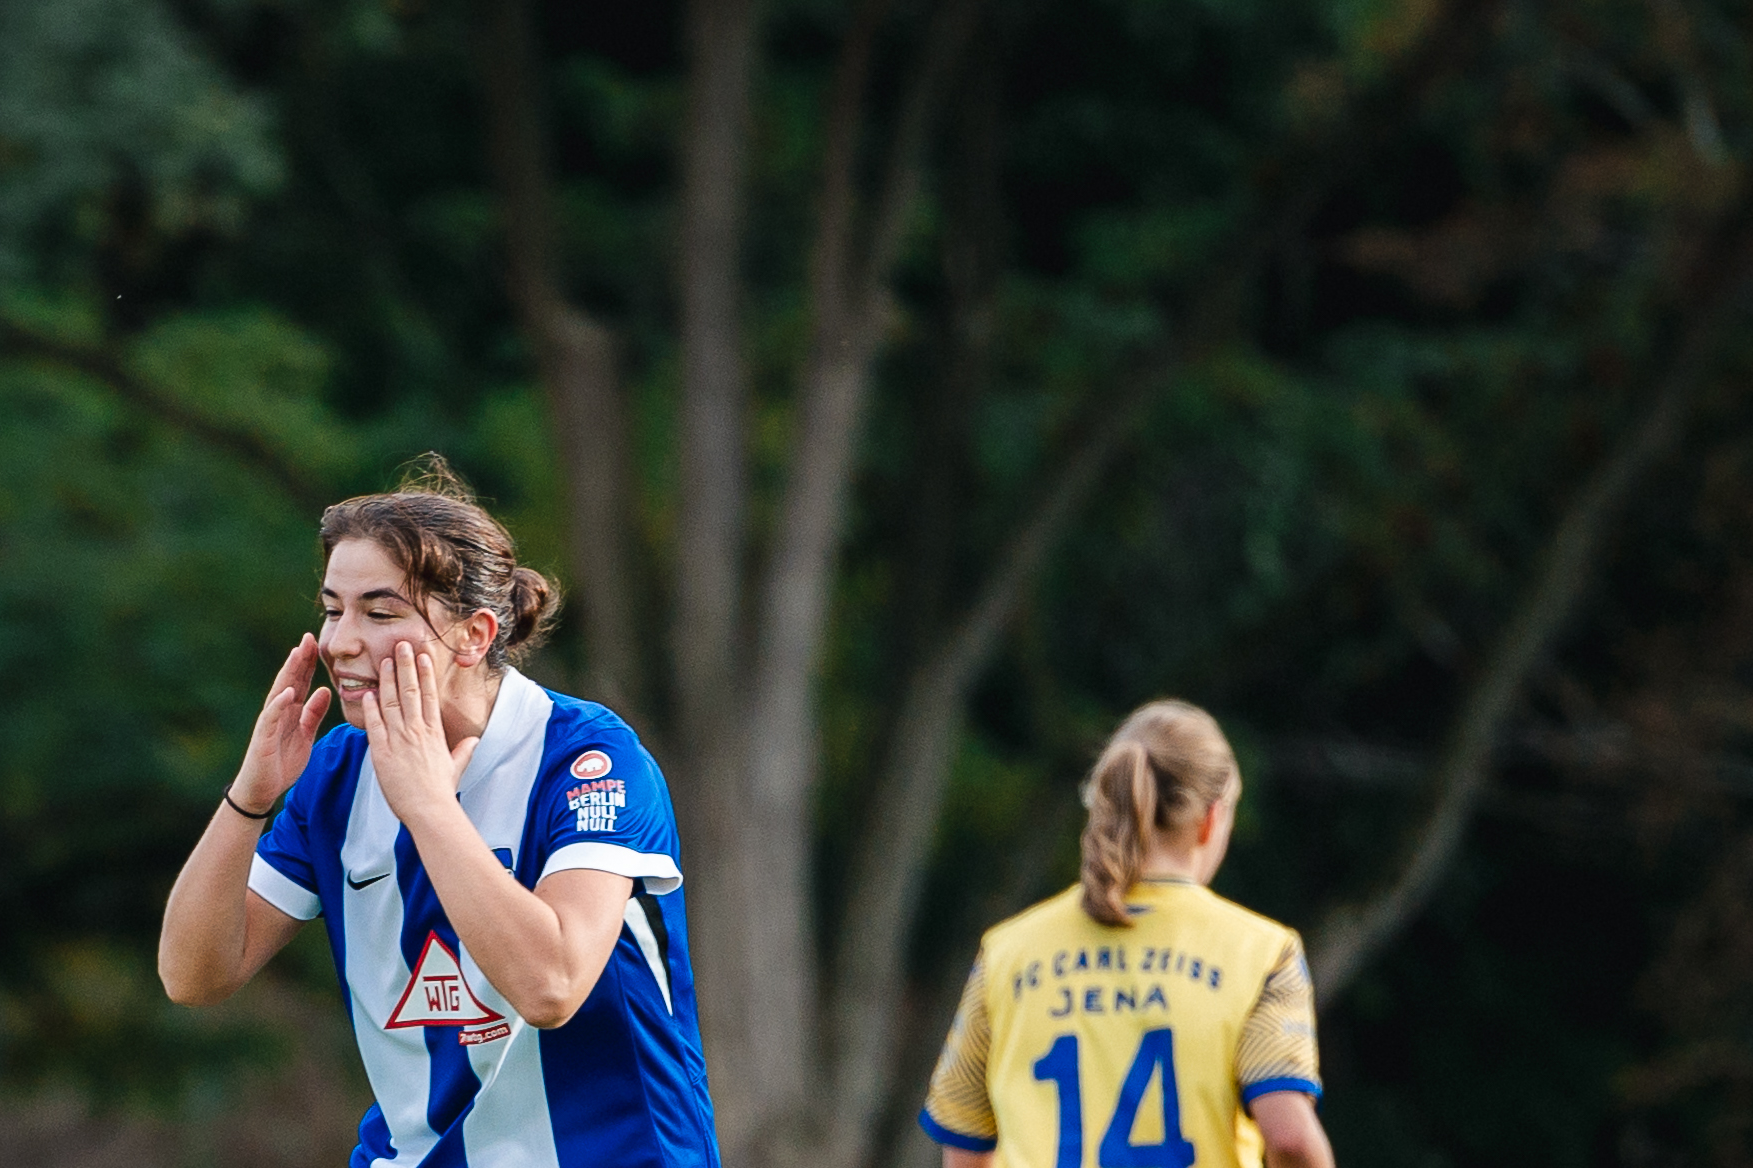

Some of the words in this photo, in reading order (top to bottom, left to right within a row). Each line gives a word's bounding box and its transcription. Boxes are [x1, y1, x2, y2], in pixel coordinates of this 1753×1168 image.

[566, 779, 626, 800] MAMPE
[569, 791, 625, 811] BERLIN
[577, 805, 617, 820] NULL
[576, 818, 616, 832] NULL
[1054, 947, 1127, 977] CARL
[1142, 948, 1222, 989] ZEISS
[423, 975, 460, 1012] WTG
[1049, 986, 1169, 1018] JENA
